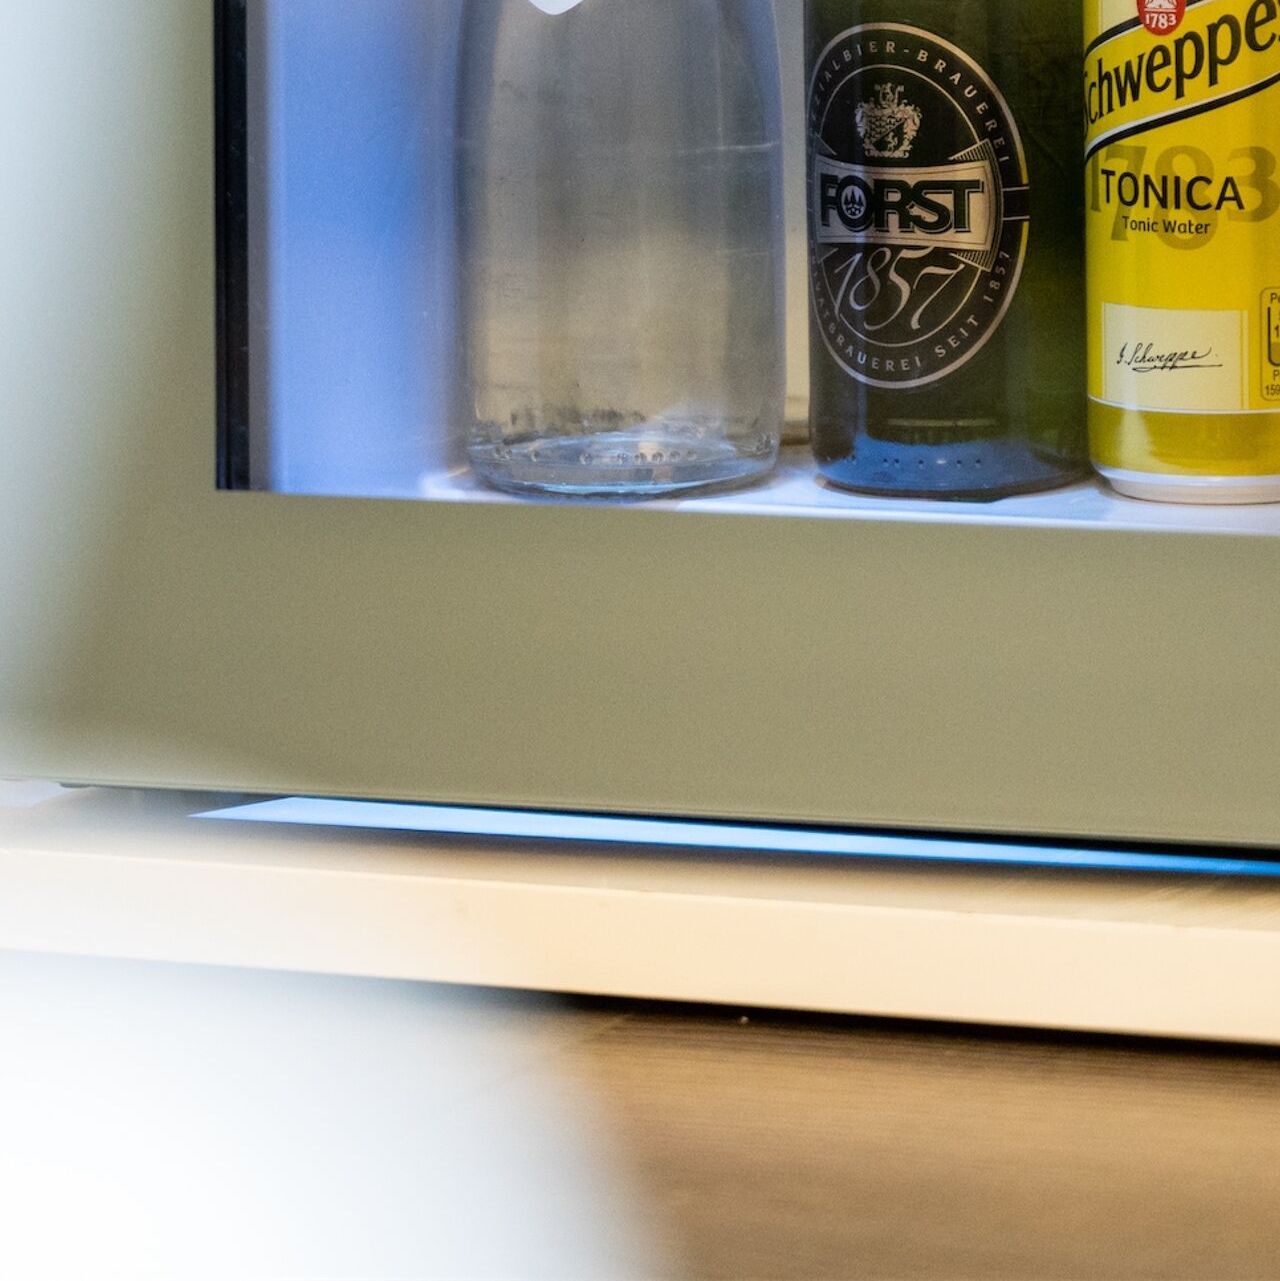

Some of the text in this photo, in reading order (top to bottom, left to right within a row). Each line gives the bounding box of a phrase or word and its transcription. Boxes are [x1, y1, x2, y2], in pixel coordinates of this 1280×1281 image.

[1145, 13, 1177, 30] 1783
[821, 173, 984, 234] FORST
[1101, 169, 1245, 211] TONICA
[1122, 216, 1211, 235] Tonic Water
[834, 245, 967, 331] 1857
[935, 314, 980, 359] SEIT
[983, 250, 1013, 304] 1857
[1265, 384, 1280, 396] 159
